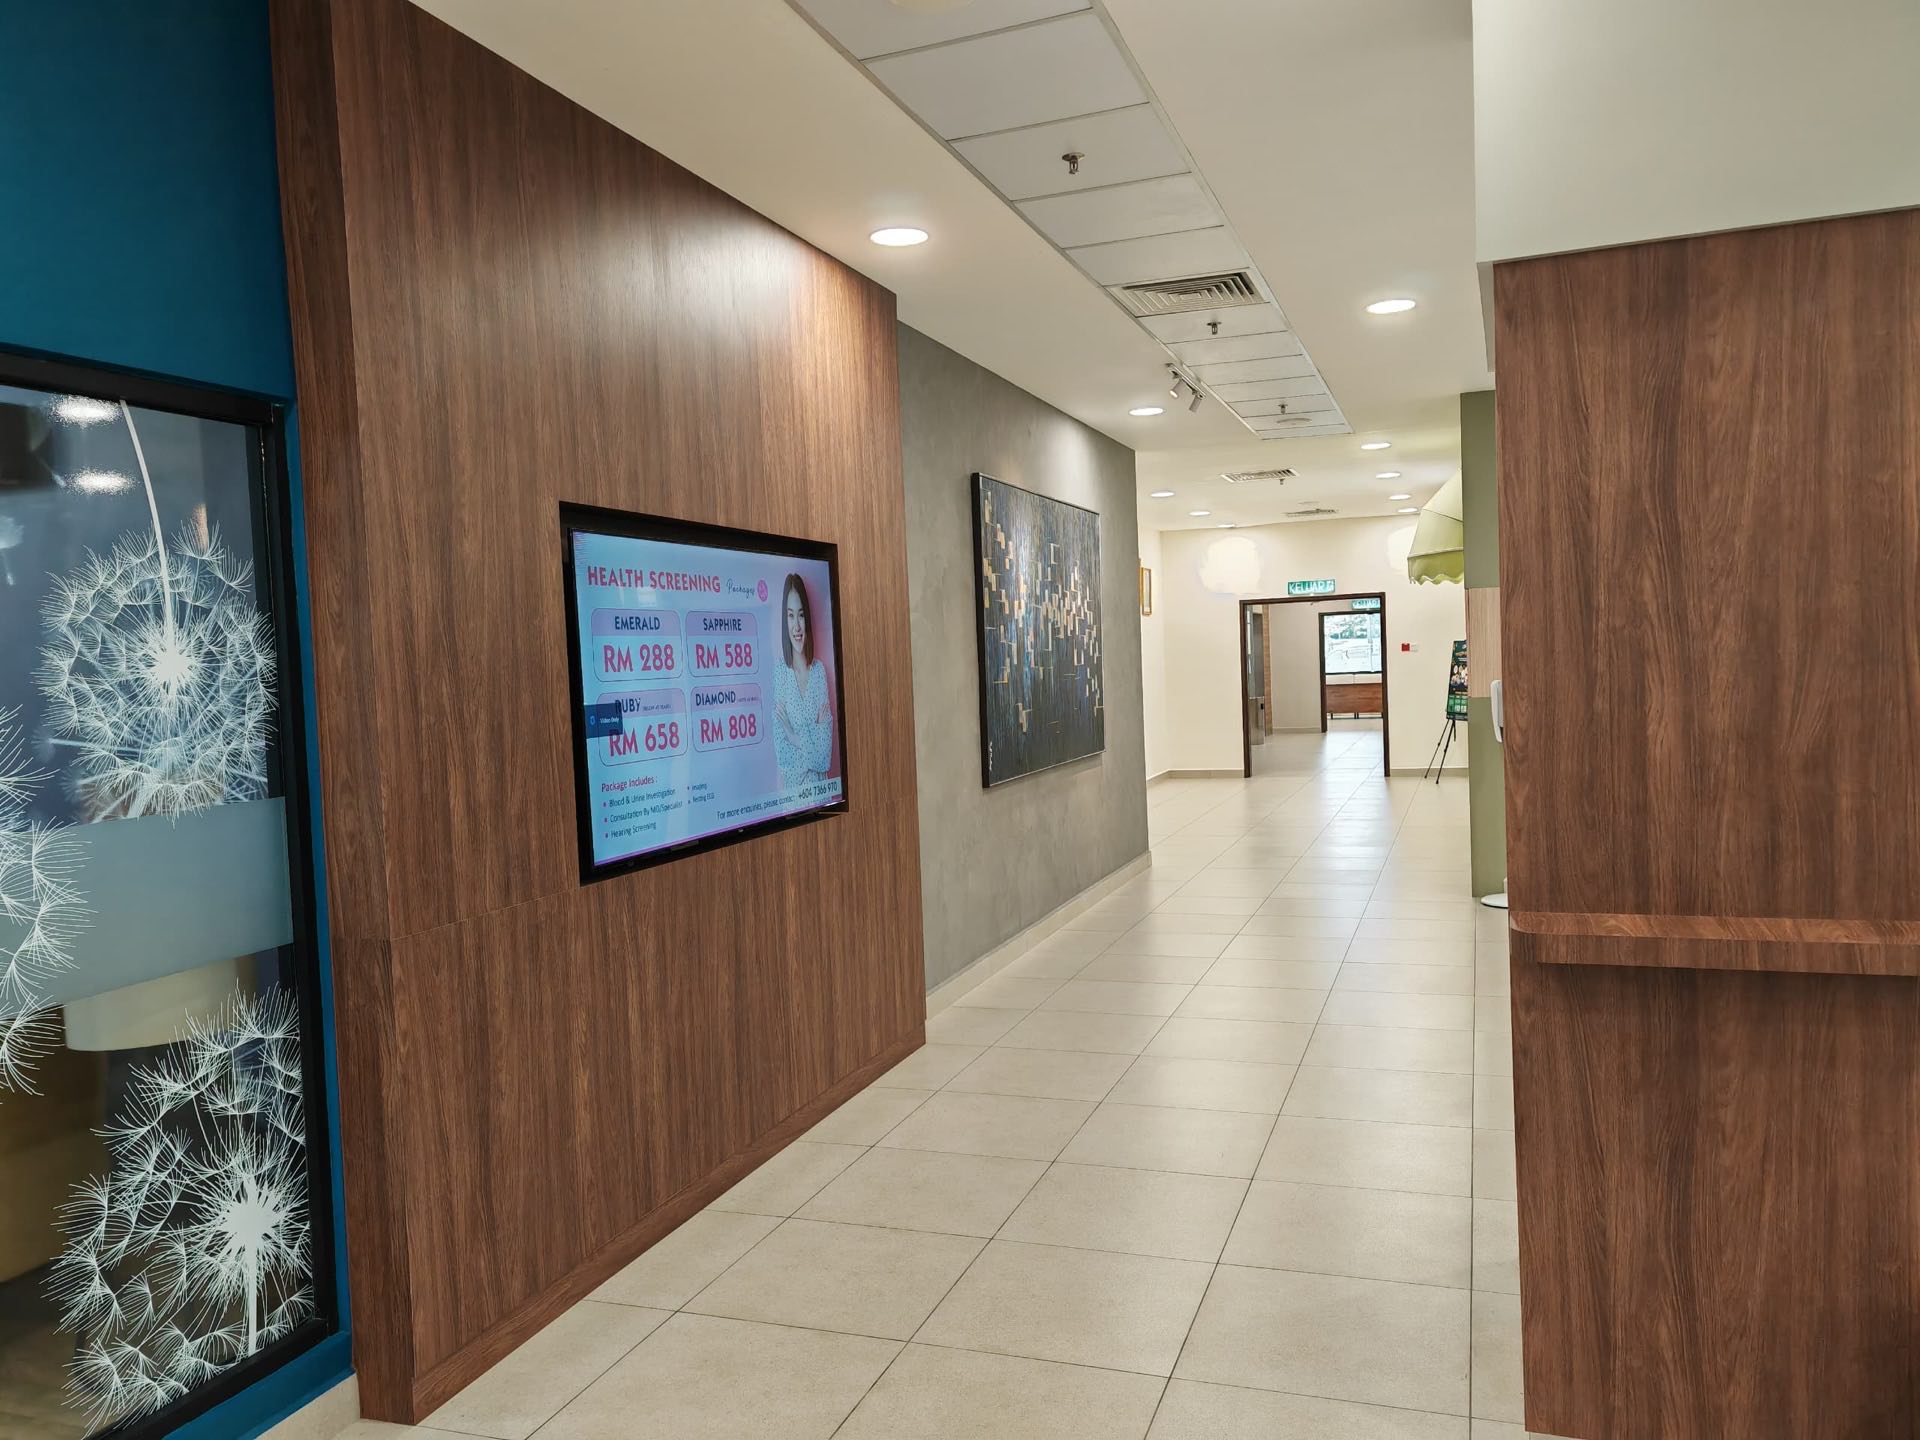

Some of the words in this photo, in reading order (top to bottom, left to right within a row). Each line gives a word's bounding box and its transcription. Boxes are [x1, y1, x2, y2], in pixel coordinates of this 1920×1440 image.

[587, 565, 644, 588] HEALTH
[649, 570, 721, 593] SCREENING
[1289, 581, 1326, 594] KELUAR
[614, 615, 661, 631] EMERALD
[703, 618, 742, 631] SAPPHIRE
[603, 645, 633, 673] RM
[639, 644, 675, 672] 288
[695, 643, 720, 669] RM
[725, 643, 753, 668] 588
[615, 698, 641, 714] RUBY
[695, 691, 736, 706] DIAMOND
[700, 718, 723, 744] RM
[729, 713, 757, 740] 808
[609, 727, 639, 757] RM
[644, 722, 680, 752] 658
[601, 780, 628, 793] Package
[628, 776, 655, 787] Includes
[798, 788, 812, 800] +604
[813, 785, 827, 797] 7366
[828, 781, 838, 793] 970
[609, 797, 625, 808] Blood
[626, 796, 630, 804] &
[631, 794, 646, 803] Urine
[646, 788, 676, 801] Investigation
[610, 808, 643, 823] Consultation
[643, 807, 650, 816] By
[717, 810, 726, 821] For
[727, 809, 740, 818] more
[763, 799, 778, 809] please
[610, 827, 632, 839] Hearing
[632, 821, 657, 834] Screening
